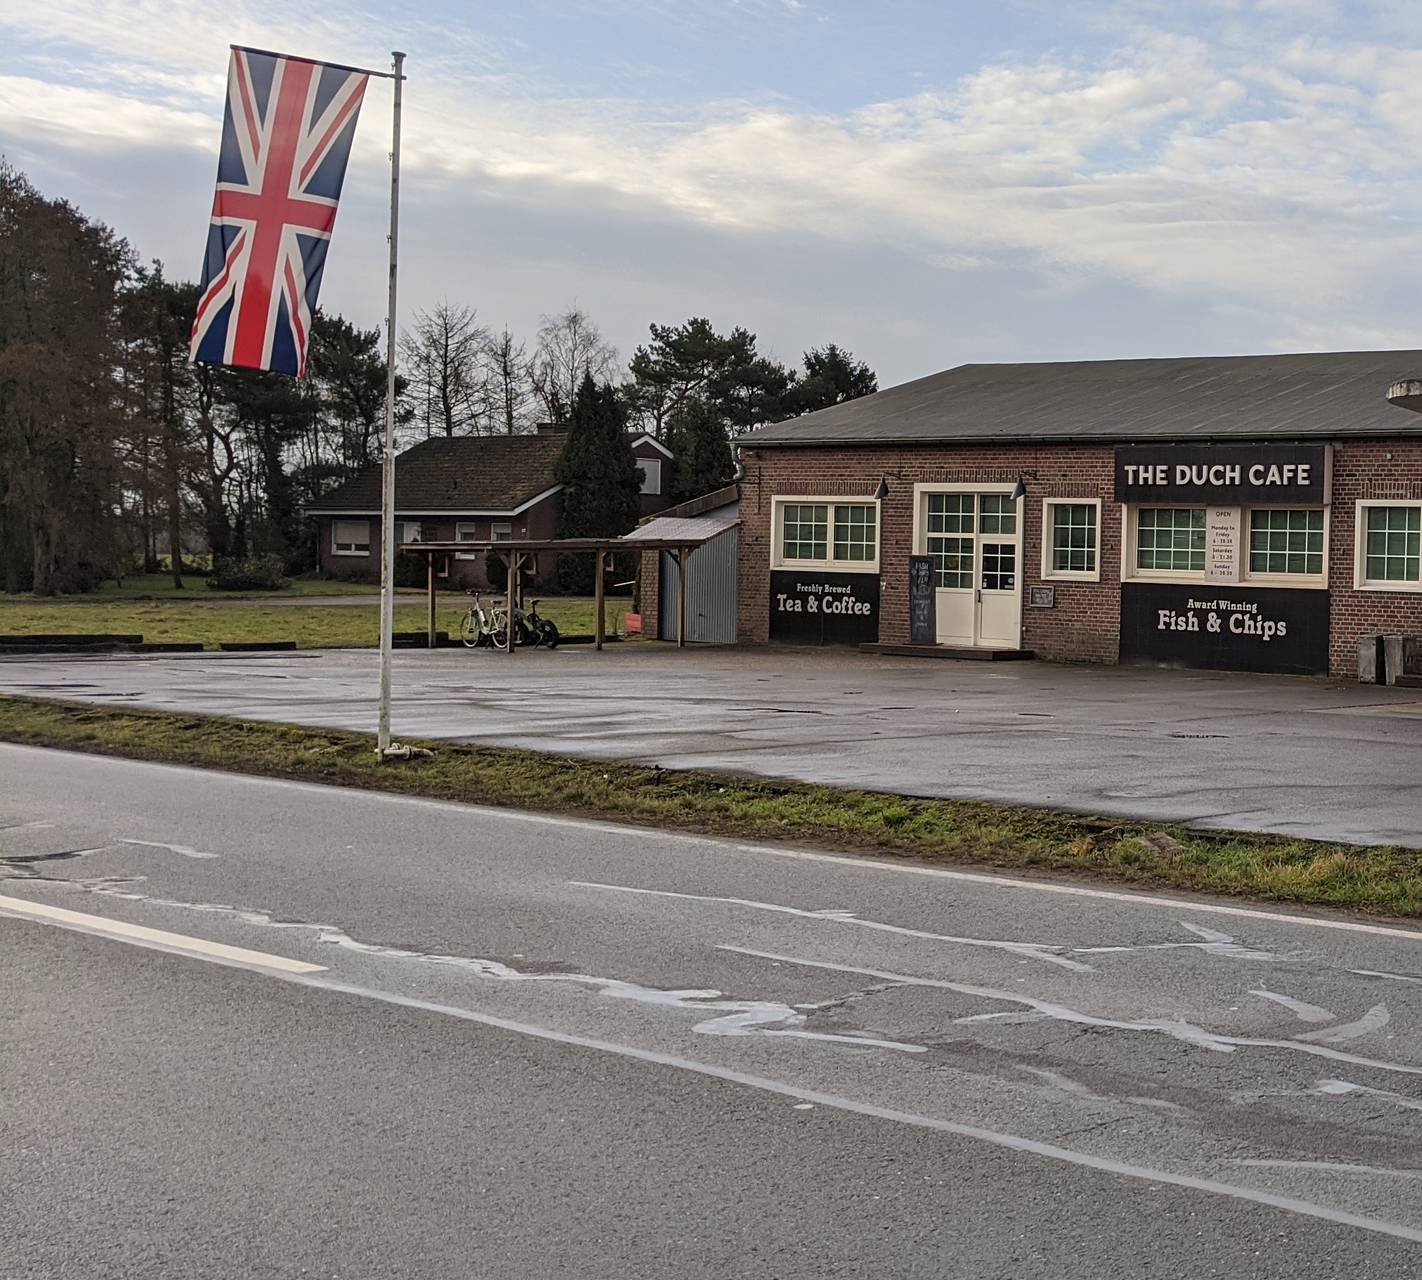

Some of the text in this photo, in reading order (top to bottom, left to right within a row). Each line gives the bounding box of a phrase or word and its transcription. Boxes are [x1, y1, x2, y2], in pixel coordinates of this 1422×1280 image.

[1124, 464, 1311, 486] THE DUCH CAFE
[796, 583, 851, 595] Freshly Brewed
[776, 593, 871, 615] Tea & Coffee
[1186, 598, 1258, 614] Award Winning
[1157, 609, 1287, 641] Fish & Chips
